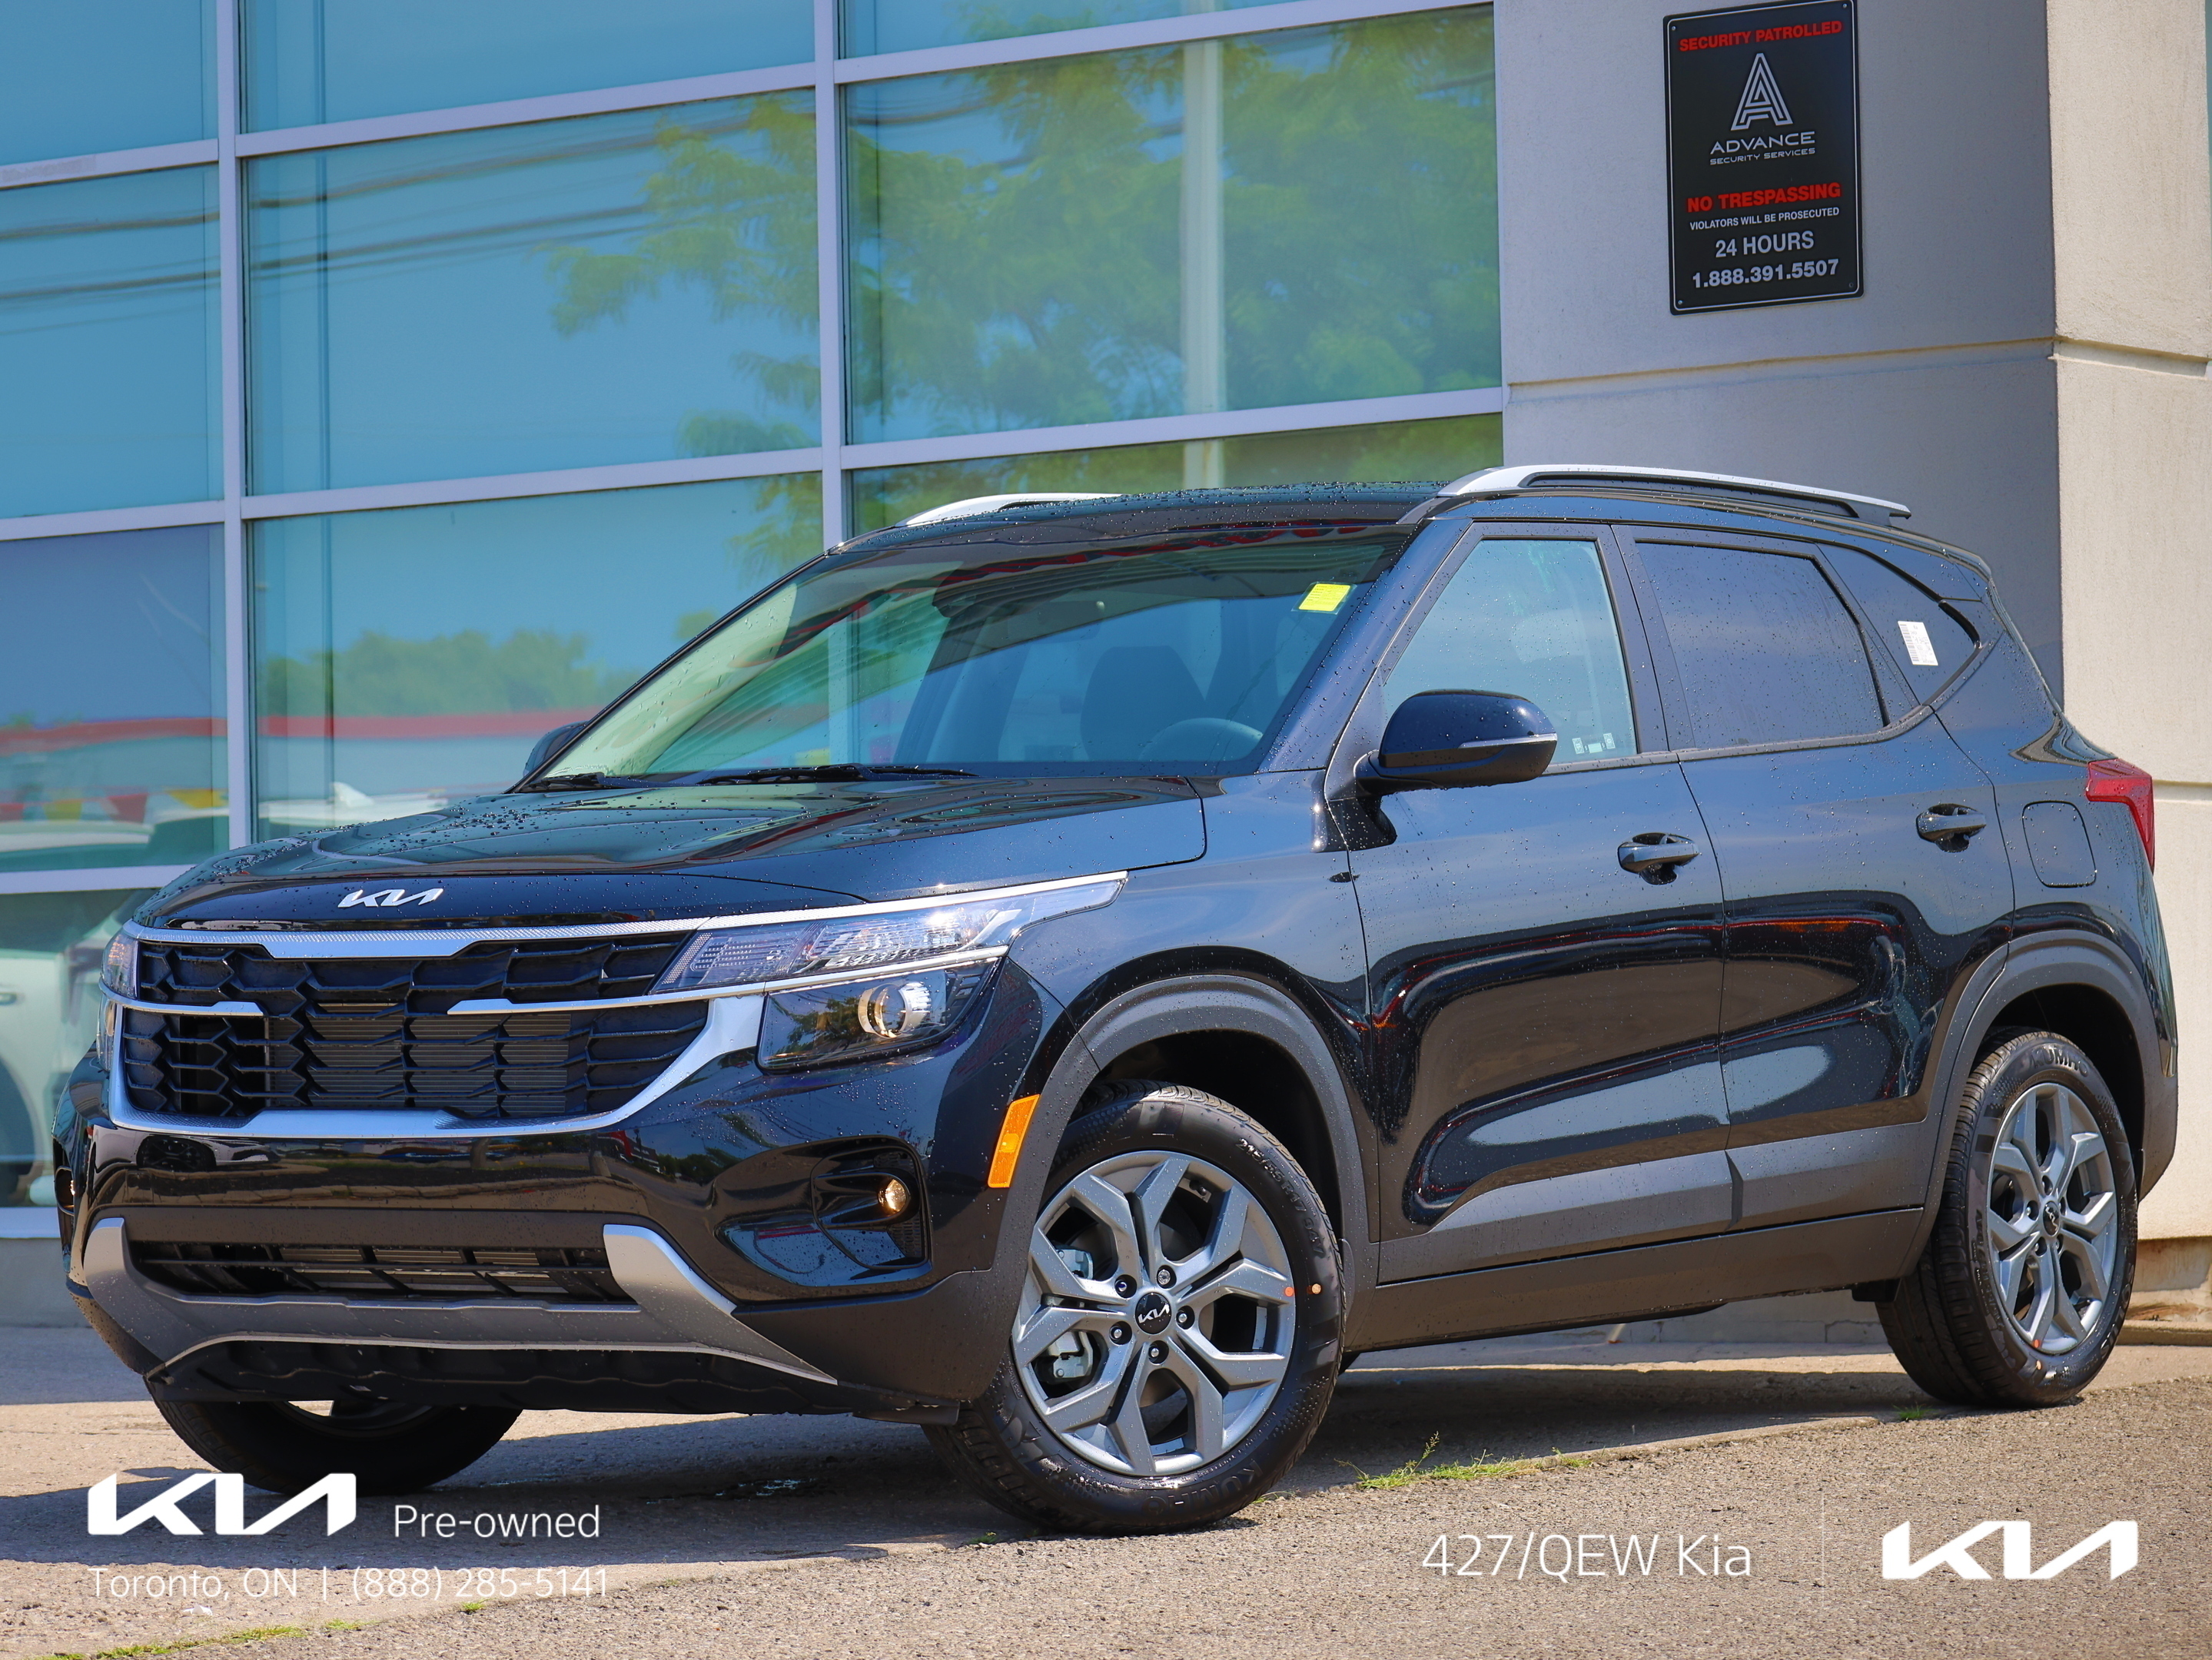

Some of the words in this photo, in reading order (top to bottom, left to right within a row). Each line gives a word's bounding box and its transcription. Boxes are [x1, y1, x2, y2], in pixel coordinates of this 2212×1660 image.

[1679, 32, 1751, 51] SECURITY
[1755, 21, 1842, 42] PATROLLED
[1710, 131, 1815, 154] ADVANCE
[1710, 154, 1760, 165] SECURITY
[1764, 148, 1815, 159] SERVICES
[1687, 197, 1712, 212] NO
[1718, 182, 1841, 209] TRESPASSING
[1690, 217, 1739, 230] VIOLATORS
[1741, 214, 1762, 225] WILL
[1764, 213, 1777, 223] BE
[1779, 207, 1839, 222] PROSECUTED
[1715, 239, 1736, 257] 24
[1743, 231, 1814, 254] HOURS
[1692, 259, 1838, 288] 1.888.391.5507
